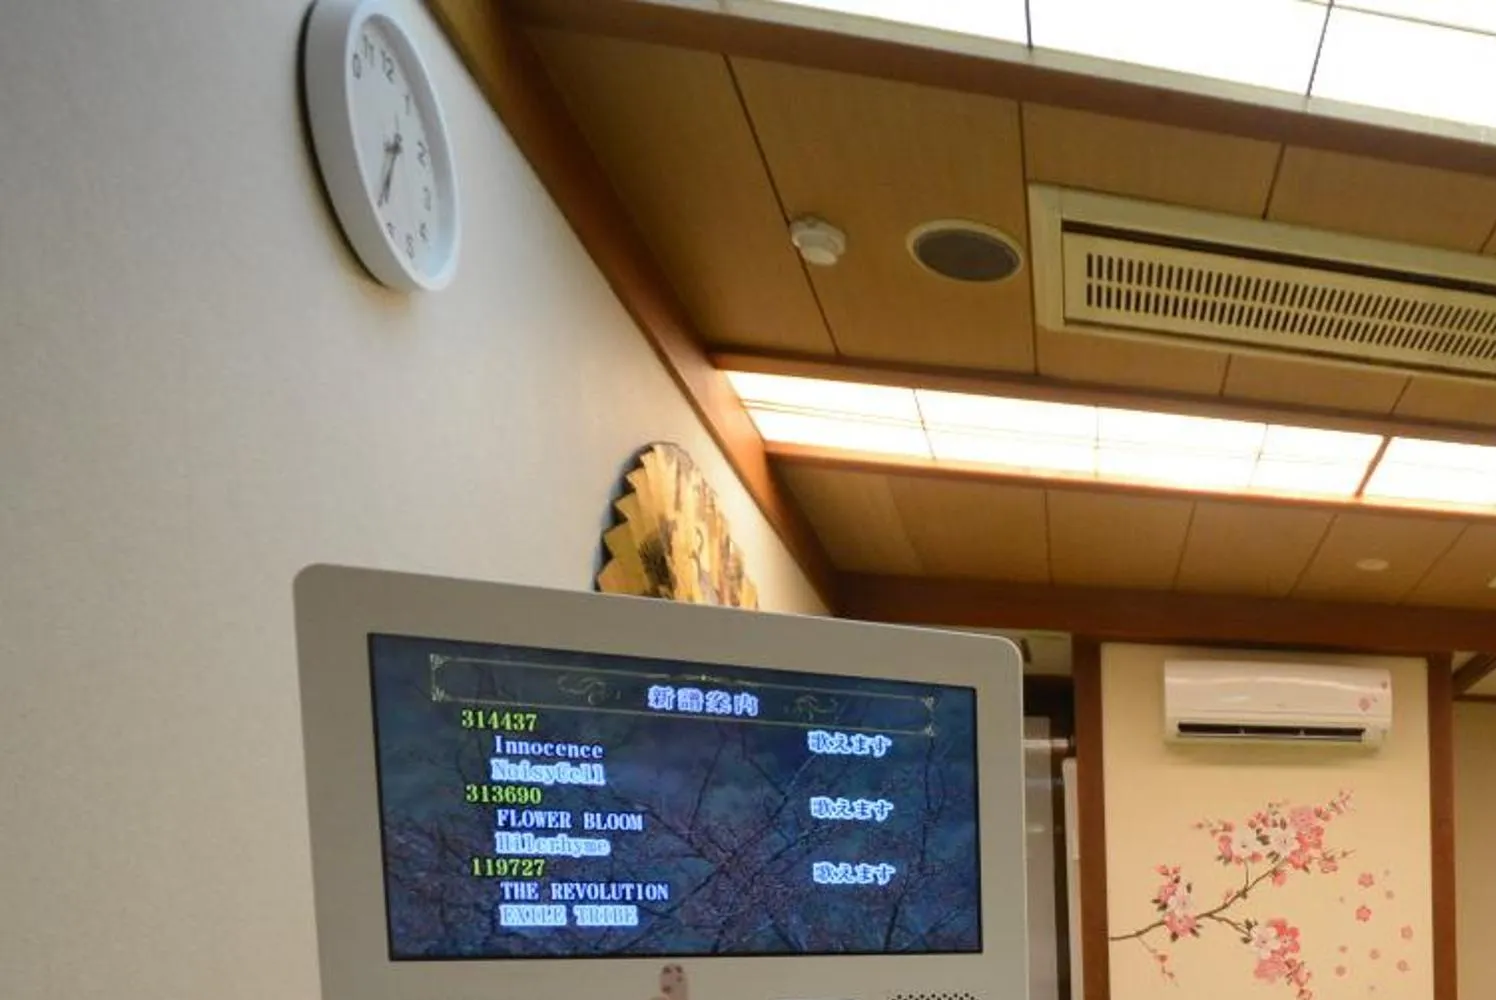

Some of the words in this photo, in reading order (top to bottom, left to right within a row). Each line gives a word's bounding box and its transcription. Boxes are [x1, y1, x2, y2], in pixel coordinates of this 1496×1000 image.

[461, 708, 538, 732] 314437
[494, 735, 604, 759] Innocence
[807, 730, 892, 757] 歌えます
[465, 784, 542, 805] 313690
[496, 808, 572, 829] FLOWER
[583, 812, 644, 831] BLOOM
[810, 796, 894, 821] 歌えます
[471, 857, 546, 877] 119727
[813, 861, 896, 885] 歌えます
[500, 881, 540, 900] THE
[550, 882, 670, 901] REVOLUTION
